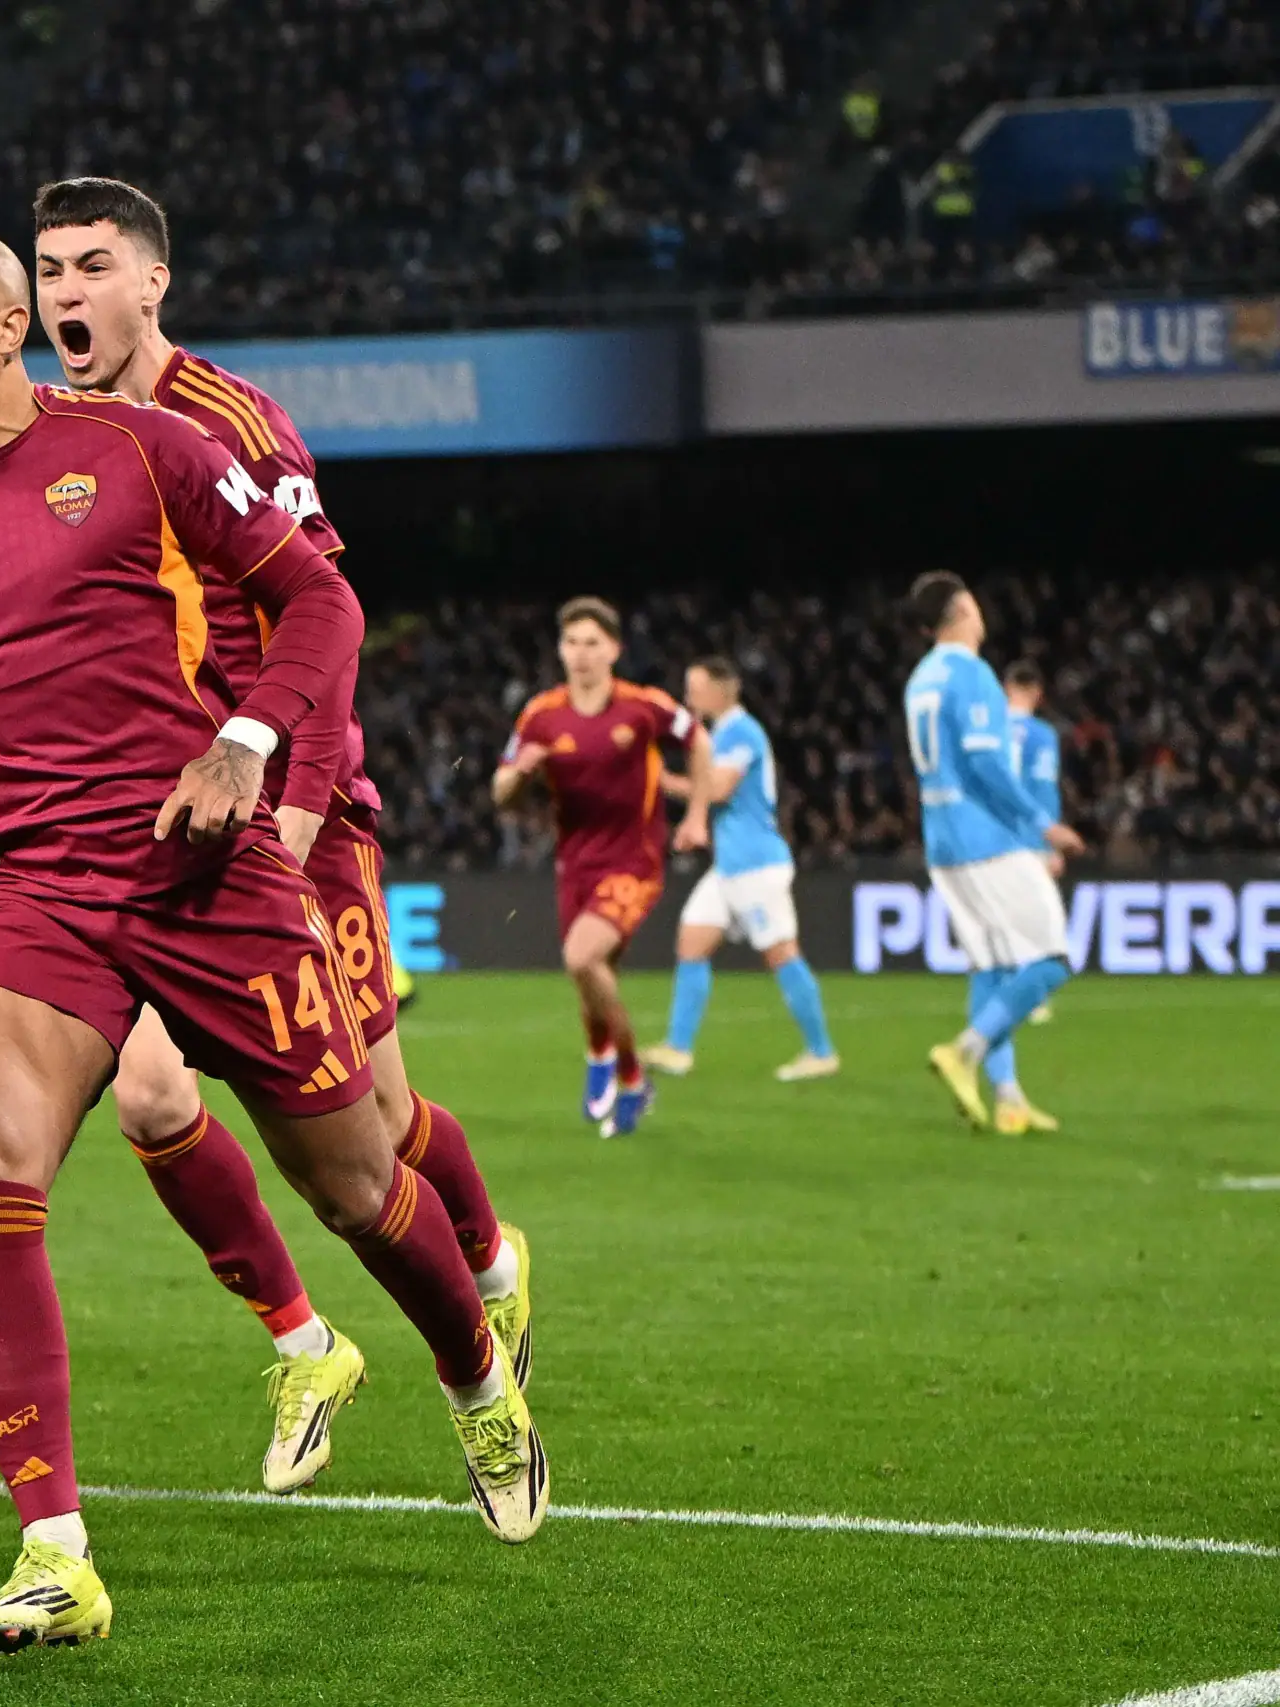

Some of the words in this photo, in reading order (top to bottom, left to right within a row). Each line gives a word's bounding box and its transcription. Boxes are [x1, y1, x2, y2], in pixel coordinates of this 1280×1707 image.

[1089, 304, 1224, 368] BLUE
[55, 499, 92, 514] ROMA
[248, 953, 334, 1052] 14
